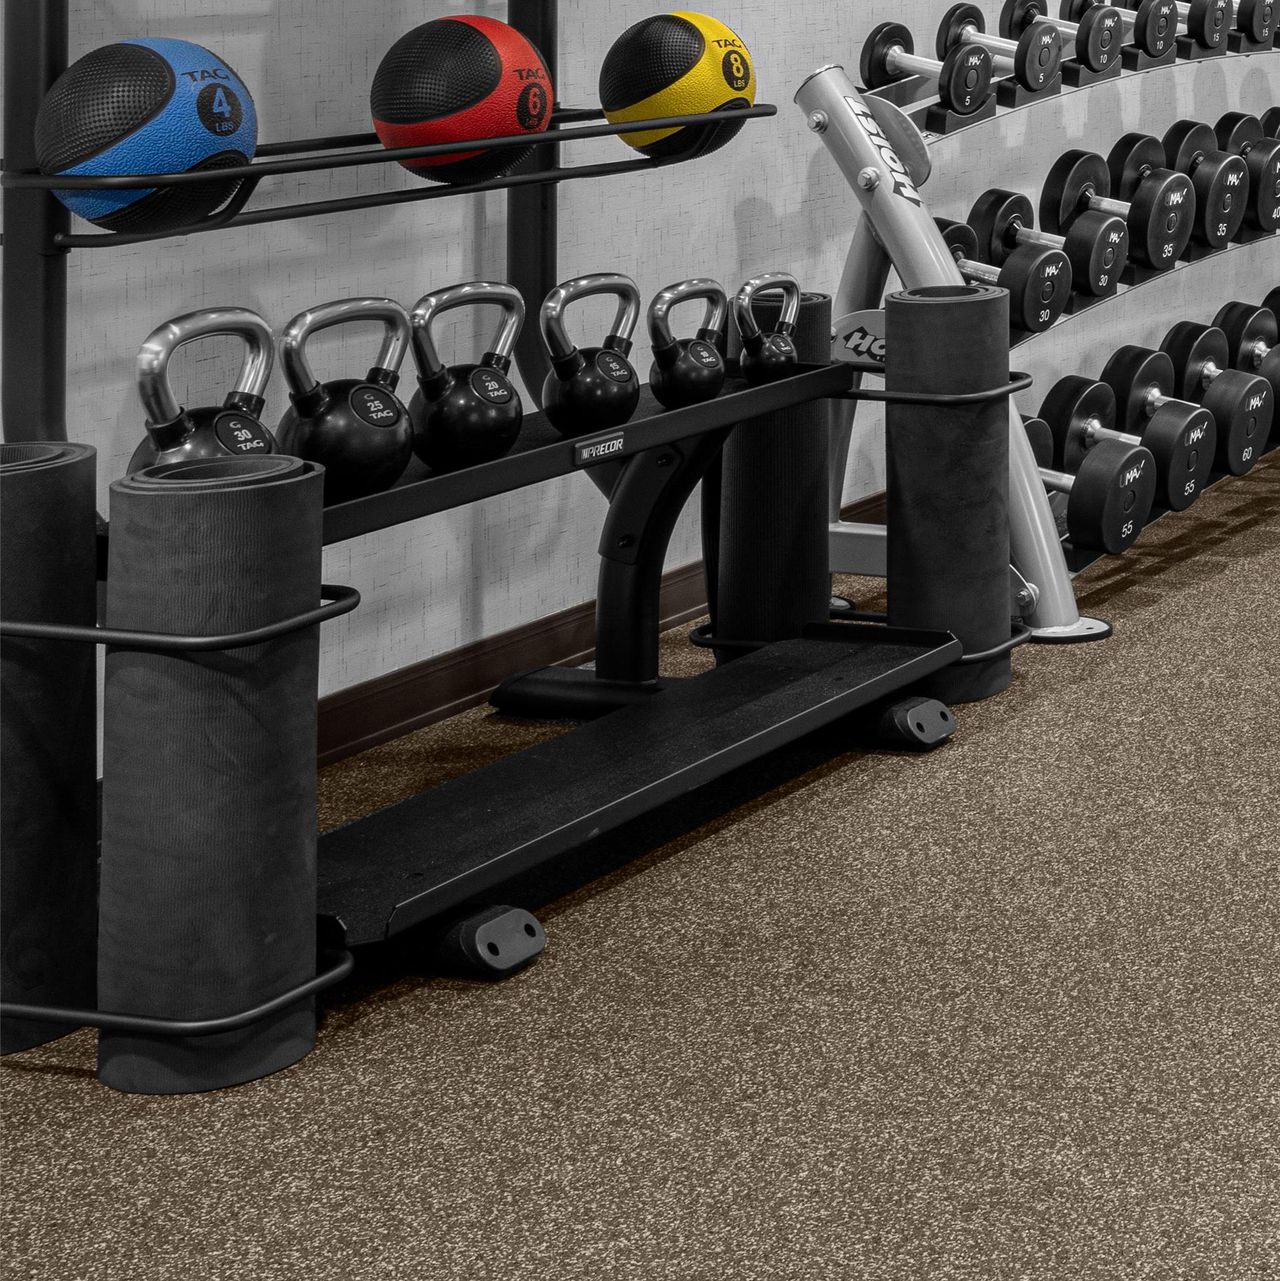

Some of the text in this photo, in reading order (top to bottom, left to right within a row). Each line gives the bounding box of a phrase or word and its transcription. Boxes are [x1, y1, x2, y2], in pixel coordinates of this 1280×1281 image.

[1156, 40, 1164, 50] 10
[1099, 54, 1108, 64] 10
[730, 53, 744, 78] 8
[733, 79, 746, 88] LBS
[1038, 72, 1044, 83] 5
[213, 87, 232, 118] 4
[528, 87, 541, 115] 6
[964, 95, 971, 106] 5
[1216, 223, 1228, 236] 35
[1162, 243, 1174, 258] 35
[1098, 274, 1109, 287] 30
[1038, 309, 1050, 322] 30
[609, 362, 620, 370] 15
[485, 381, 499, 391] 20
[367, 400, 384, 412] 25
[369, 409, 394, 420] TAG
[233, 429, 252, 441] 30
[237, 439, 265, 451] TAG
[588, 438, 625, 458] PRECOR
[1242, 446, 1253, 462] 60
[1184, 479, 1195, 496] 55
[1121, 519, 1133, 538] 55
